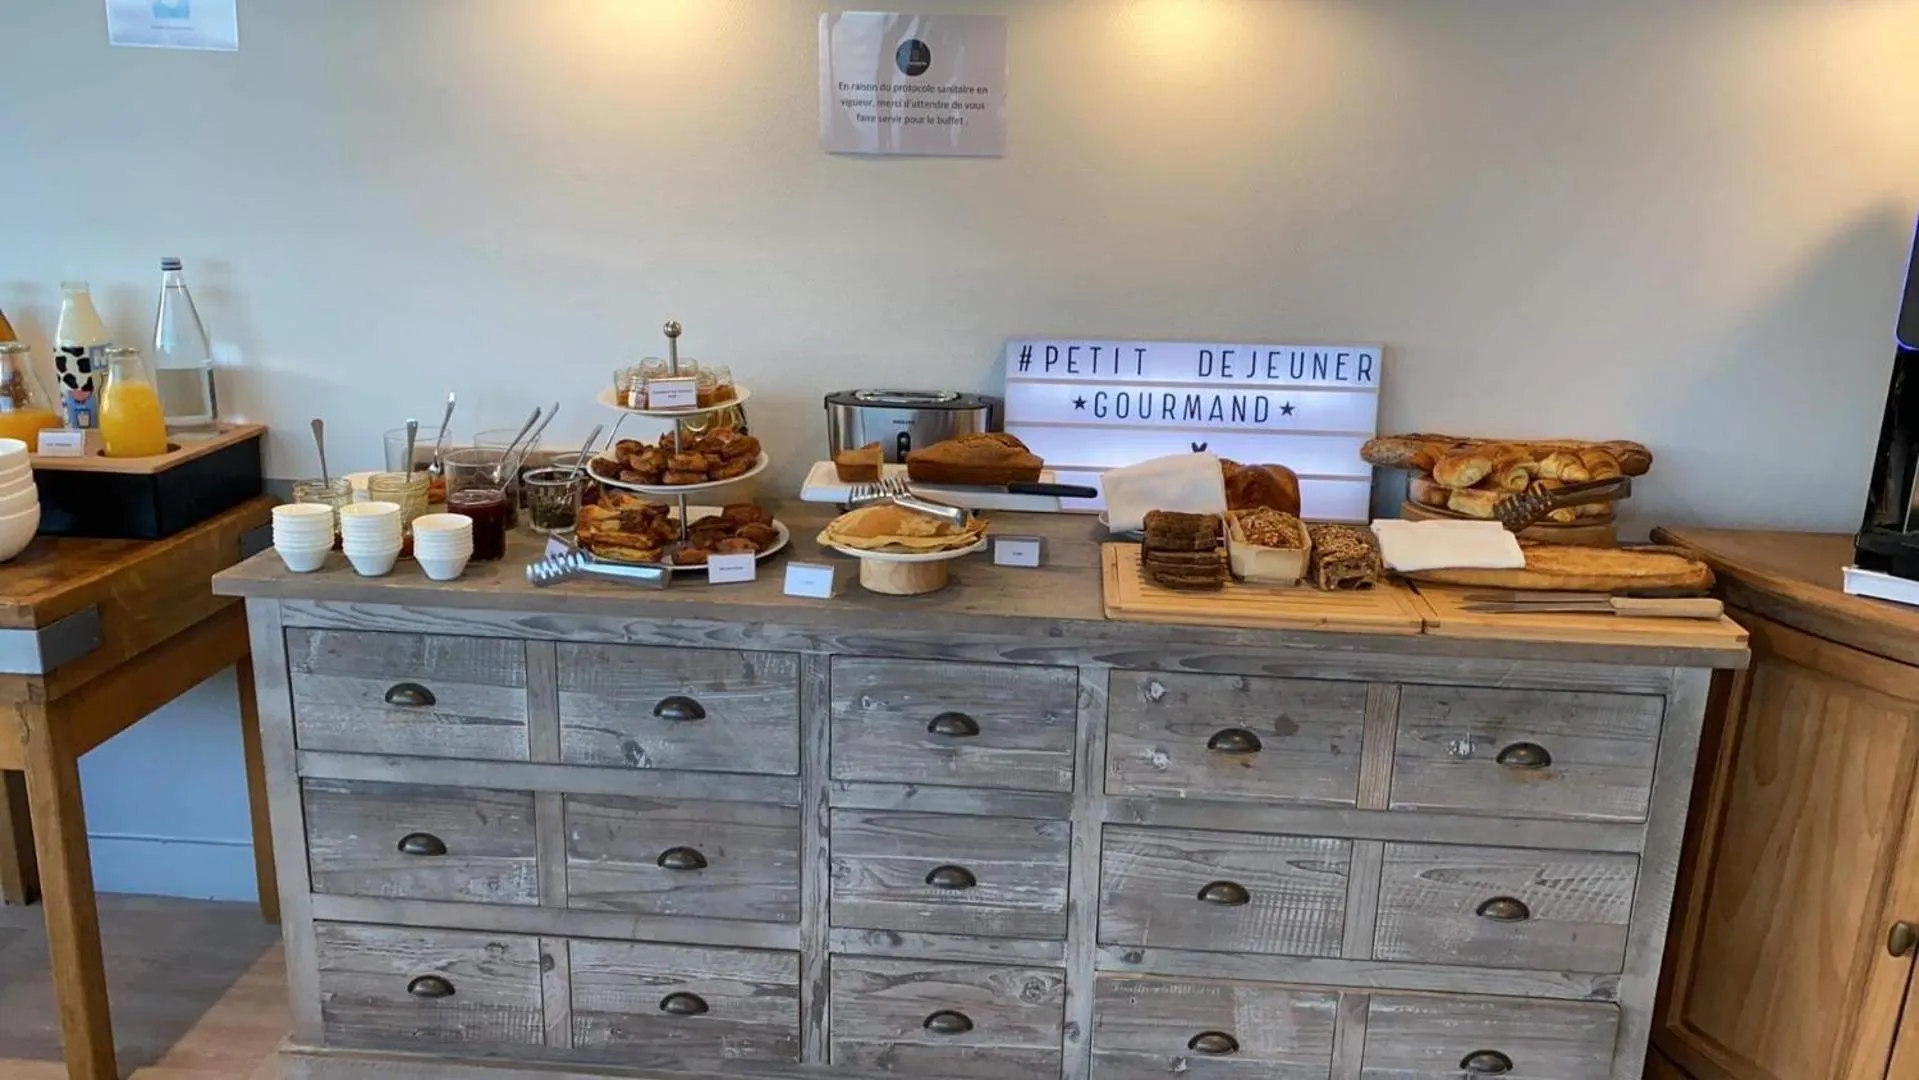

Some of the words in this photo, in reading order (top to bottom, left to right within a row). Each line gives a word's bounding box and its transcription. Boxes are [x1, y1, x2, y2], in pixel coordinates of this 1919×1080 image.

[838, 82, 850, 91] En
[879, 82, 892, 92] du
[893, 82, 935, 95] protocole
[937, 84, 975, 93] sanitaire
[976, 86, 989, 94] en
[877, 99, 902, 108] merci
[904, 99, 949, 109] d'attendre
[951, 100, 963, 109] de
[964, 102, 985, 110] vous
[856, 113, 876, 122] faire
[878, 114, 902, 123] servir
[904, 115, 926, 126] pour
[927, 115, 935, 124] le
[1018, 344, 1148, 376] #PETIT
[1197, 349, 1373, 382] DEJEUNER
[1093, 391, 1270, 423] GOURMAND
